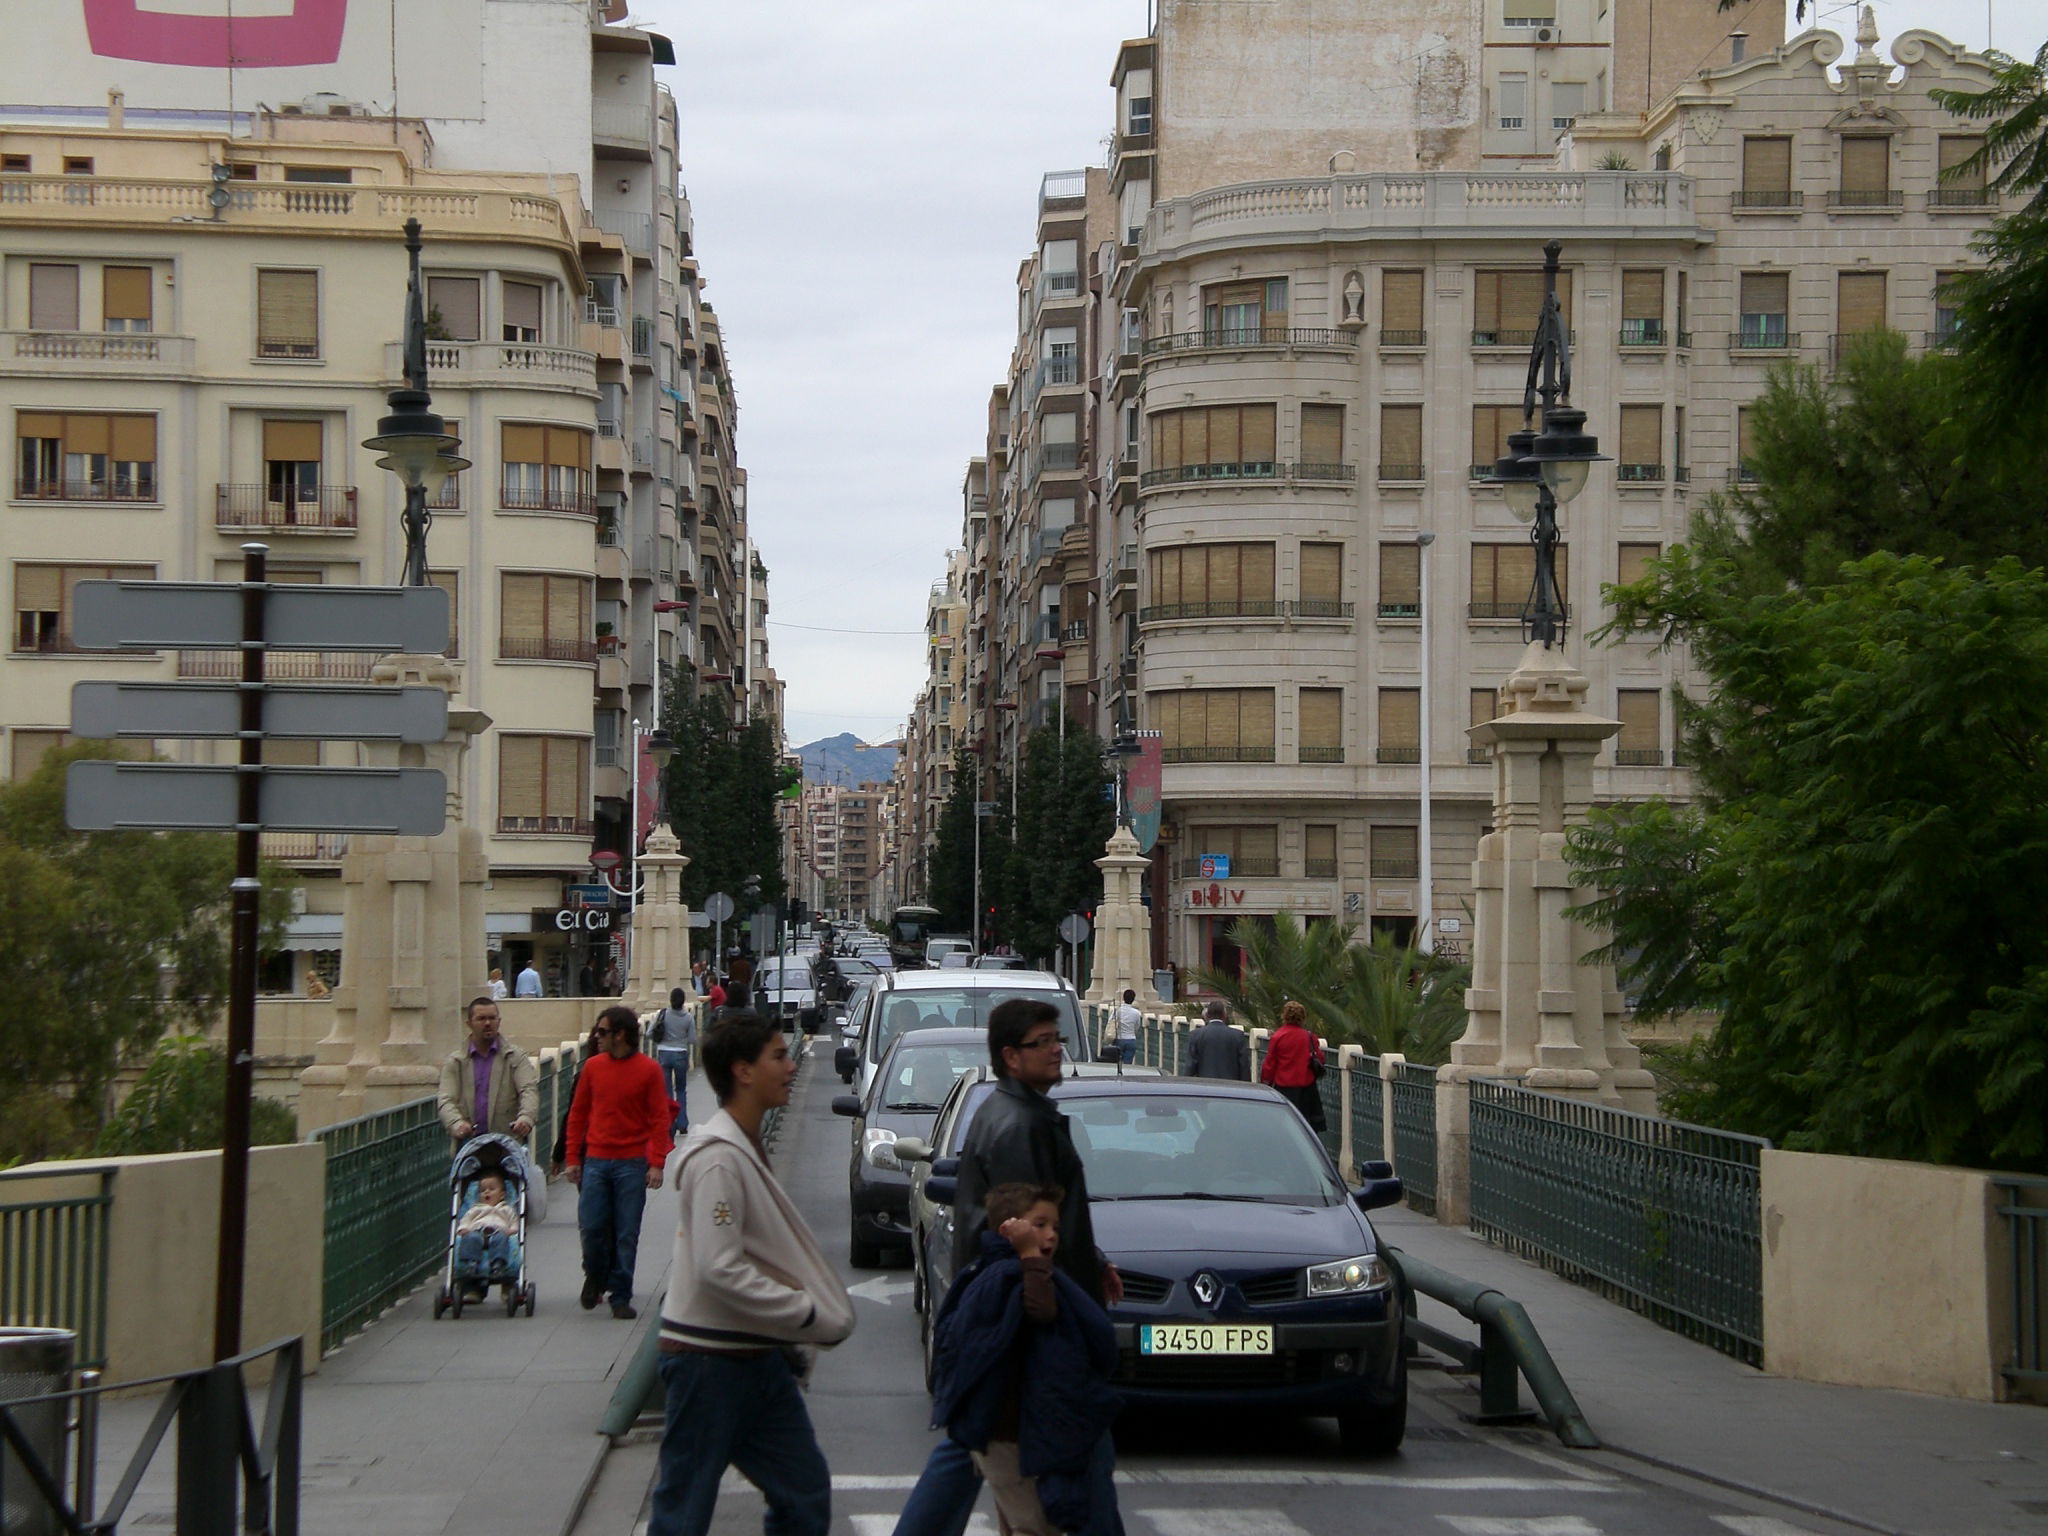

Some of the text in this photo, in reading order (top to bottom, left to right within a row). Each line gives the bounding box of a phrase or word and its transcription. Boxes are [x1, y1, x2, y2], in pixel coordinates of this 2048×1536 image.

[555, 909, 610, 931] El Cid
[1155, 1329, 1213, 1351] 3450
[1226, 1329, 1269, 1351] FPS
